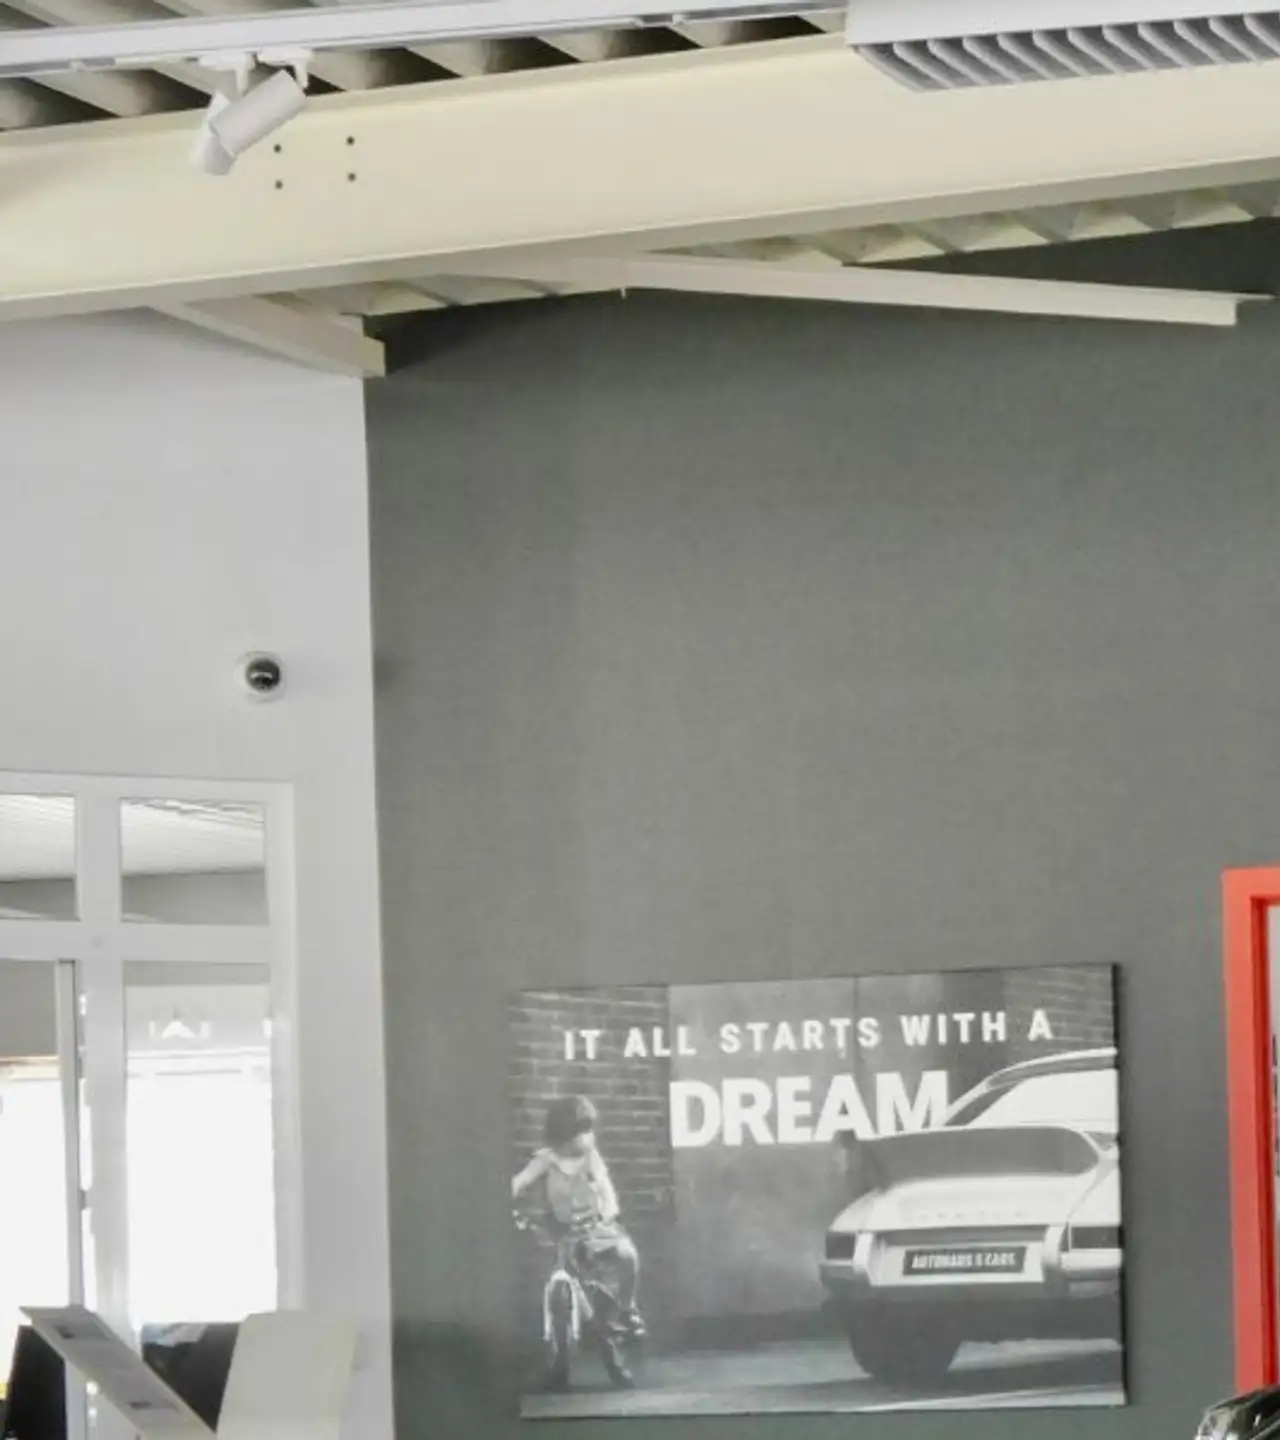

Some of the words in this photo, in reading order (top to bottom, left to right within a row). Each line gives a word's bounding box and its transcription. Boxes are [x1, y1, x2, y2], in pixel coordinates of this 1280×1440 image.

[564, 1028, 601, 1060] IT
[624, 1025, 698, 1057] ALL
[719, 1017, 881, 1054] STARTS
[901, 1011, 1007, 1046] WITH
[1027, 1008, 1053, 1041] A
[669, 1070, 949, 1148] DREAM
